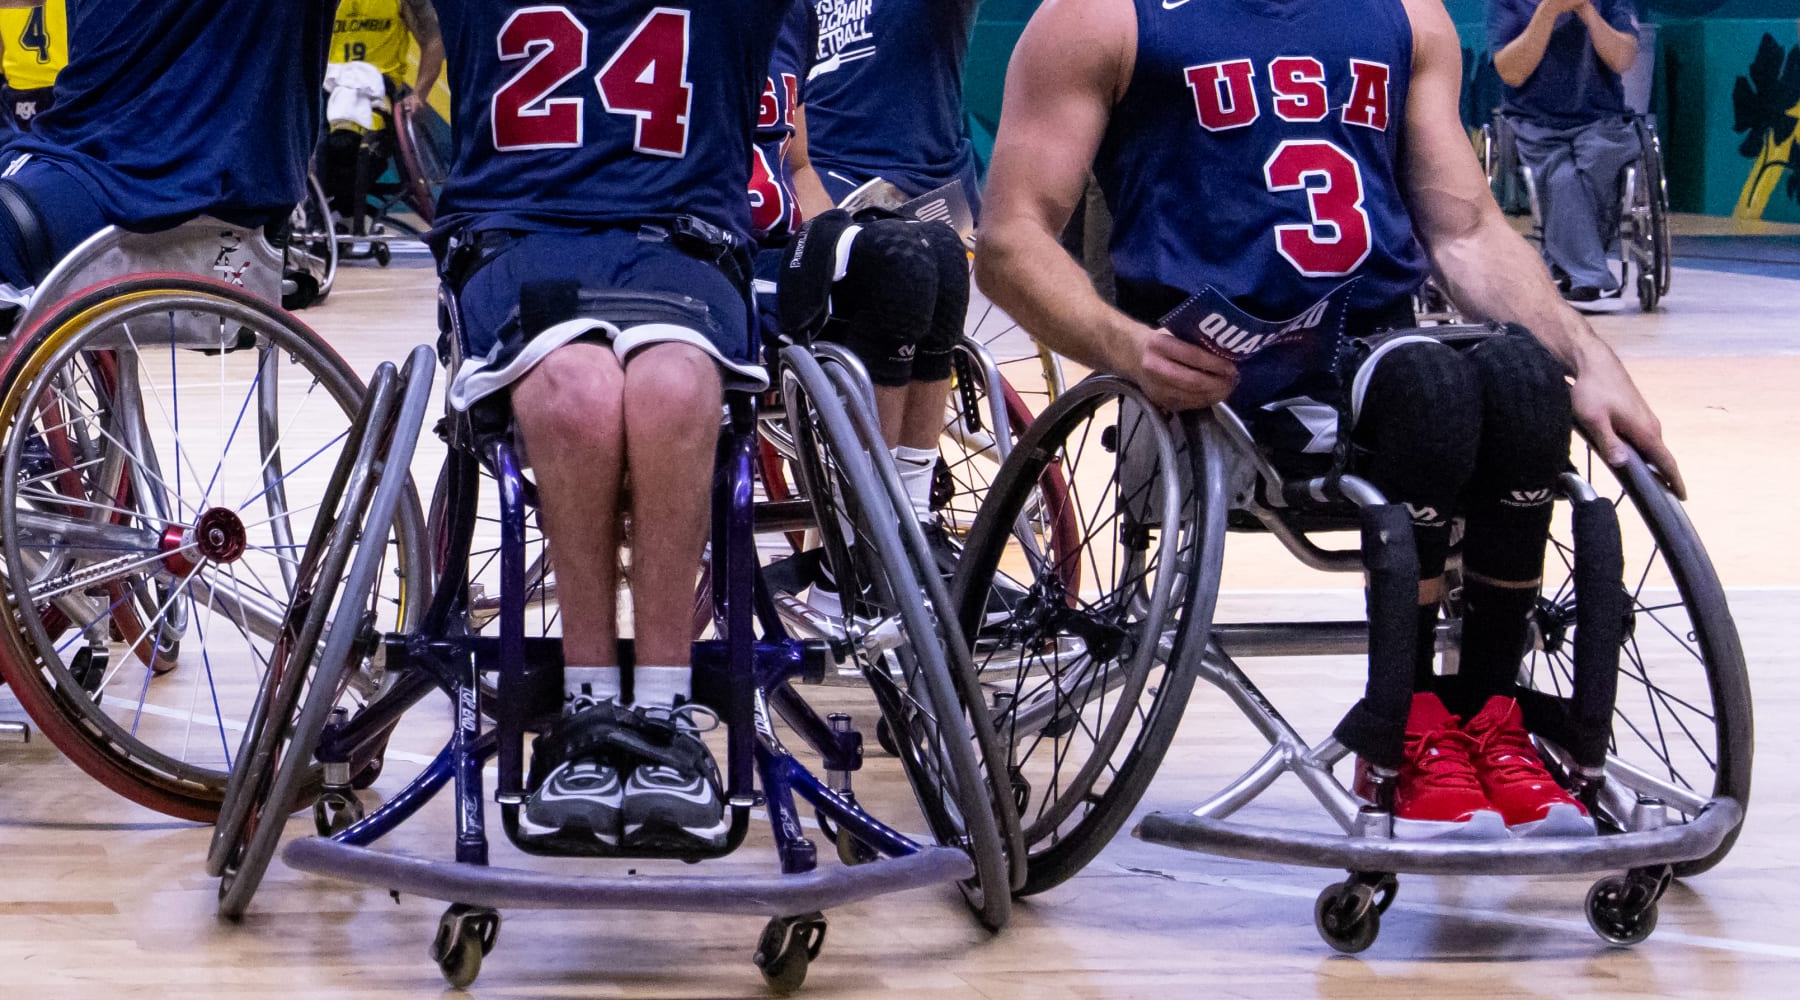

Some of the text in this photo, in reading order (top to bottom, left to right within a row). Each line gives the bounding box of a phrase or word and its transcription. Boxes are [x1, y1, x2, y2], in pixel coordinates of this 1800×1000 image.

[18, 5, 51, 64] 4
[333, 18, 392, 34] OLOMBIA
[491, 5, 693, 159] 24
[1183, 56, 1390, 133] USA
[1263, 139, 1372, 278] 3
[461, 707, 477, 733] END
